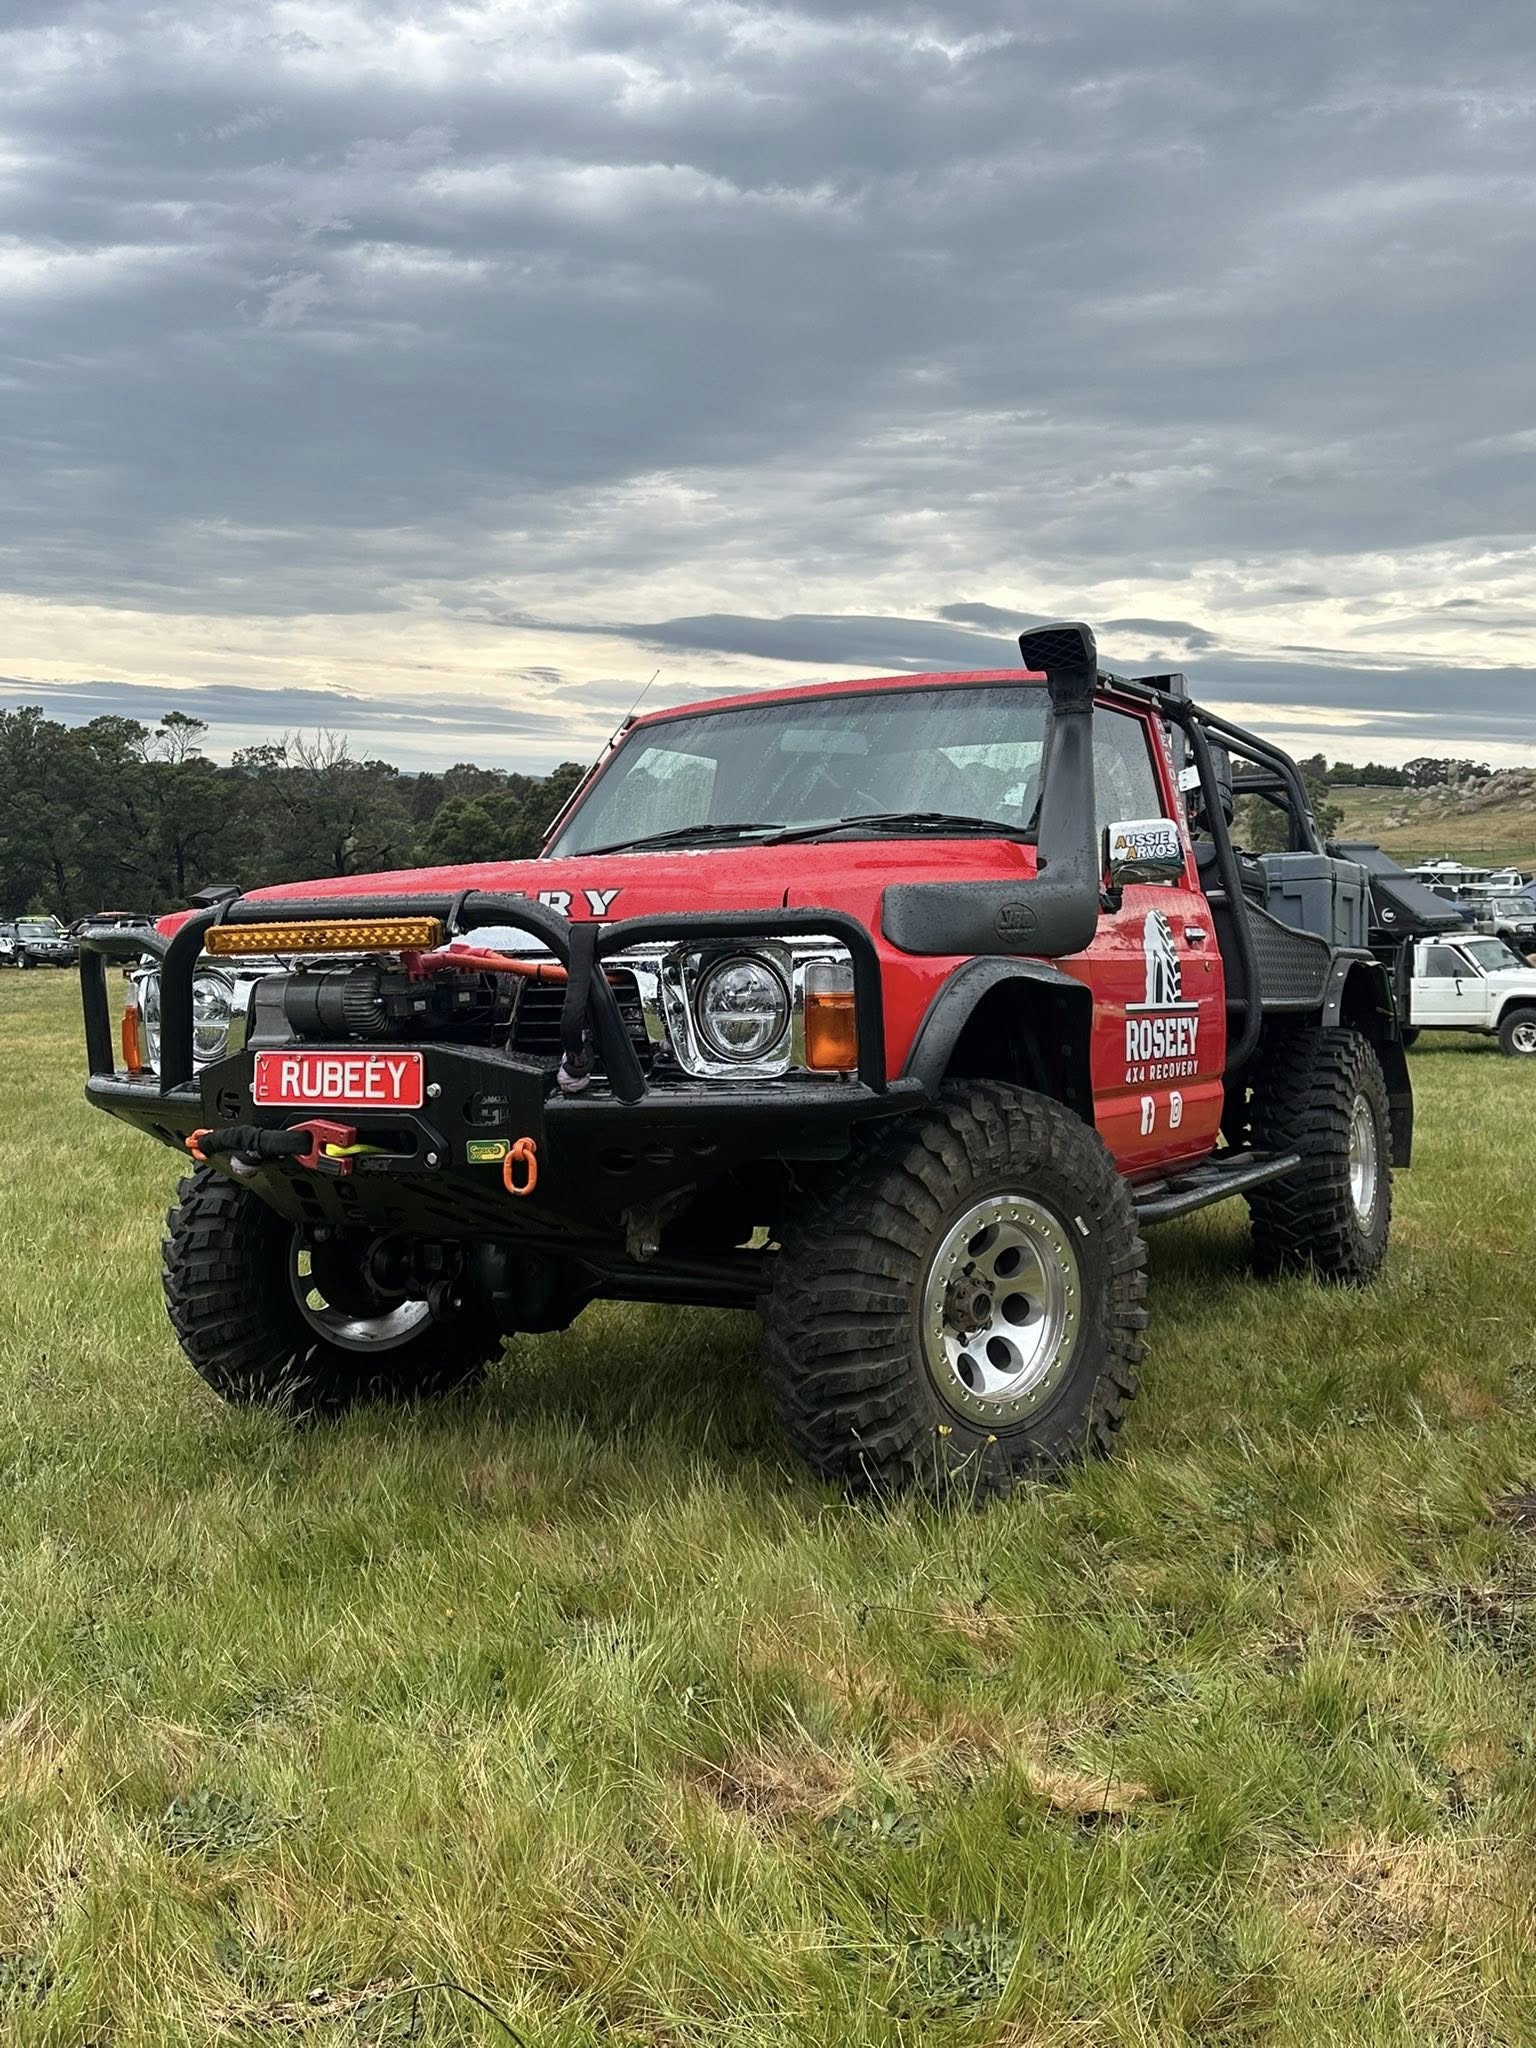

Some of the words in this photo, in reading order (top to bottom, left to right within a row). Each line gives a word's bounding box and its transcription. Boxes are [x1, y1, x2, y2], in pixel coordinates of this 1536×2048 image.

[1115, 831, 1169, 849] AUSSIE
[1126, 843, 1178, 859] ARVOS
[518, 887, 623, 917] RY
[1125, 1016, 1199, 1062] ROSEEY
[259, 1061, 270, 1097] VIC
[280, 1060, 407, 1099] RUBEEY
[1125, 1066, 1146, 1084] 4X4
[1149, 1060, 1199, 1081] RECOVERY
